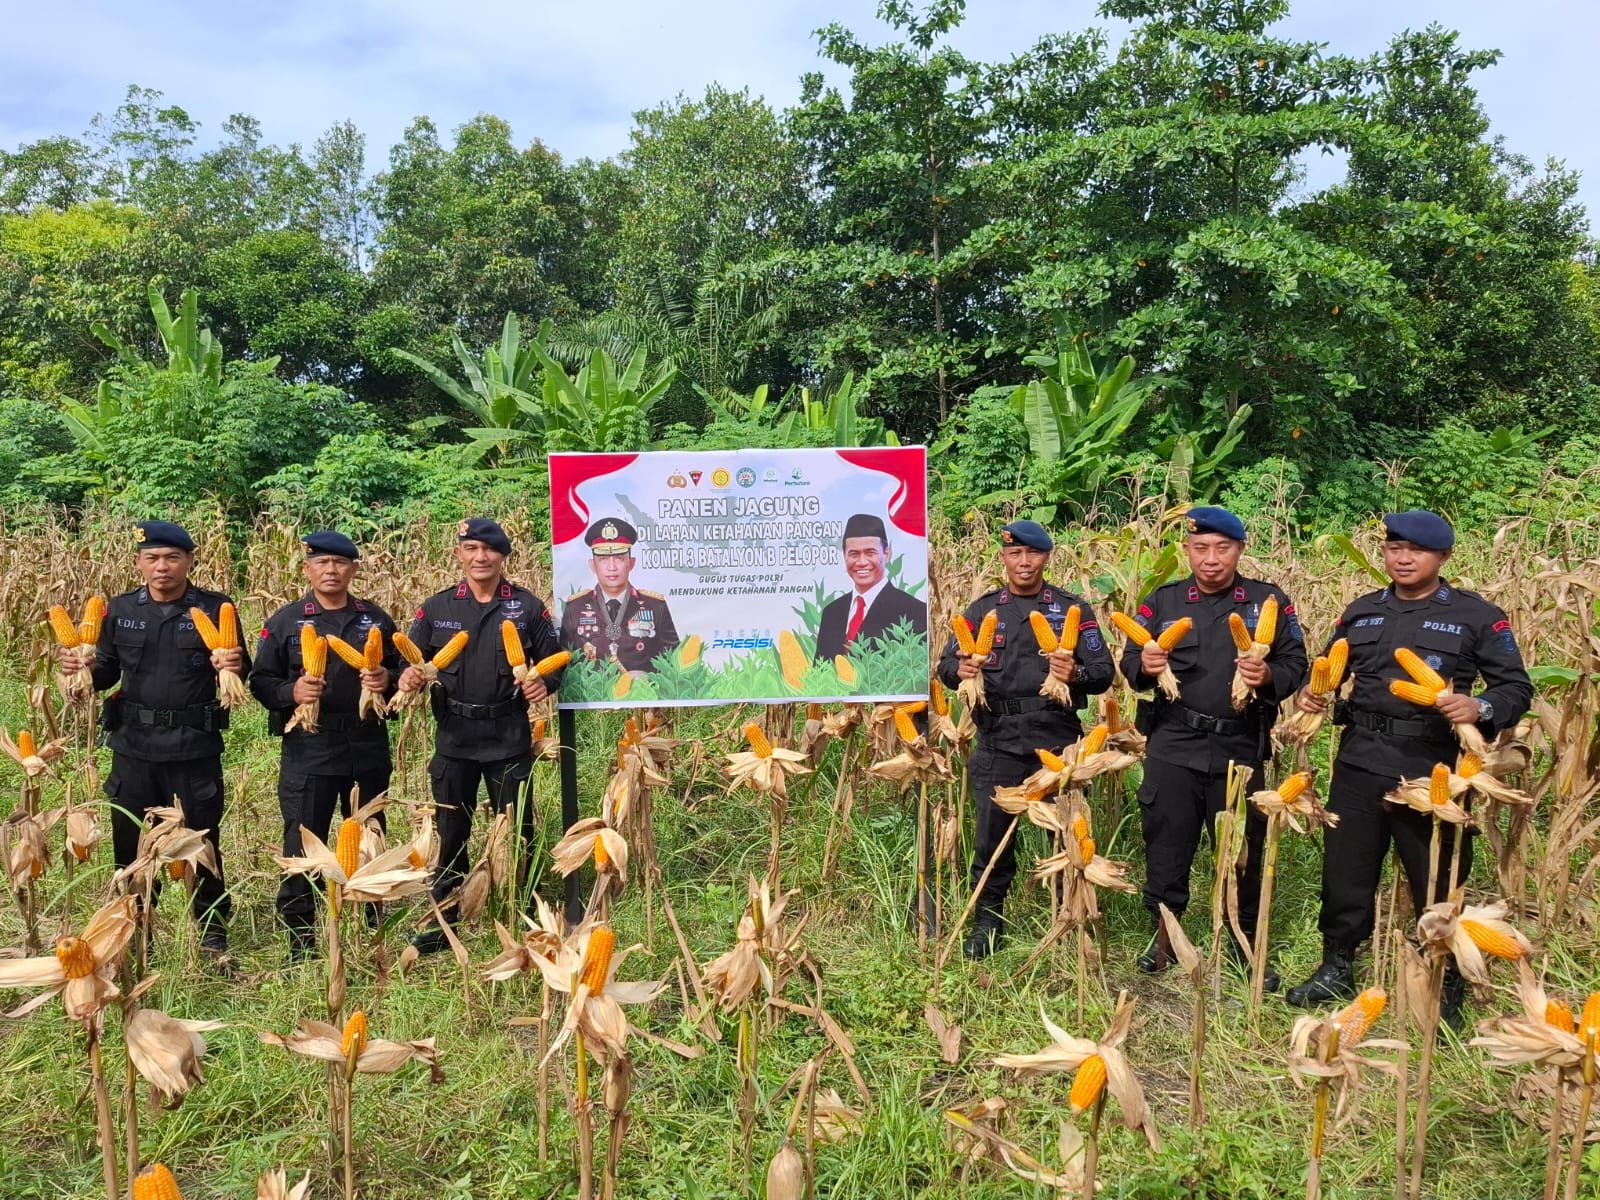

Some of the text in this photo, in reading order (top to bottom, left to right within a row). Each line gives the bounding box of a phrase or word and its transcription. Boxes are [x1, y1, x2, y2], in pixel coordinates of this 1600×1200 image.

[658, 496, 820, 518] PANEN JAGUNG
[637, 520, 842, 543] DI LAHAN KETAHANAN PANGAN
[641, 545, 839, 570] KOMPI 3 BATALYON B PELOPOR
[699, 573, 784, 584] GUGUS TUGAS POLRI
[669, 585, 814, 597] MENDUKUNG KETAHANAN PANGAN
[433, 620, 462, 630] CHARLES
[1422, 620, 1462, 635] POLRI
[712, 638, 773, 649] PRESISI
